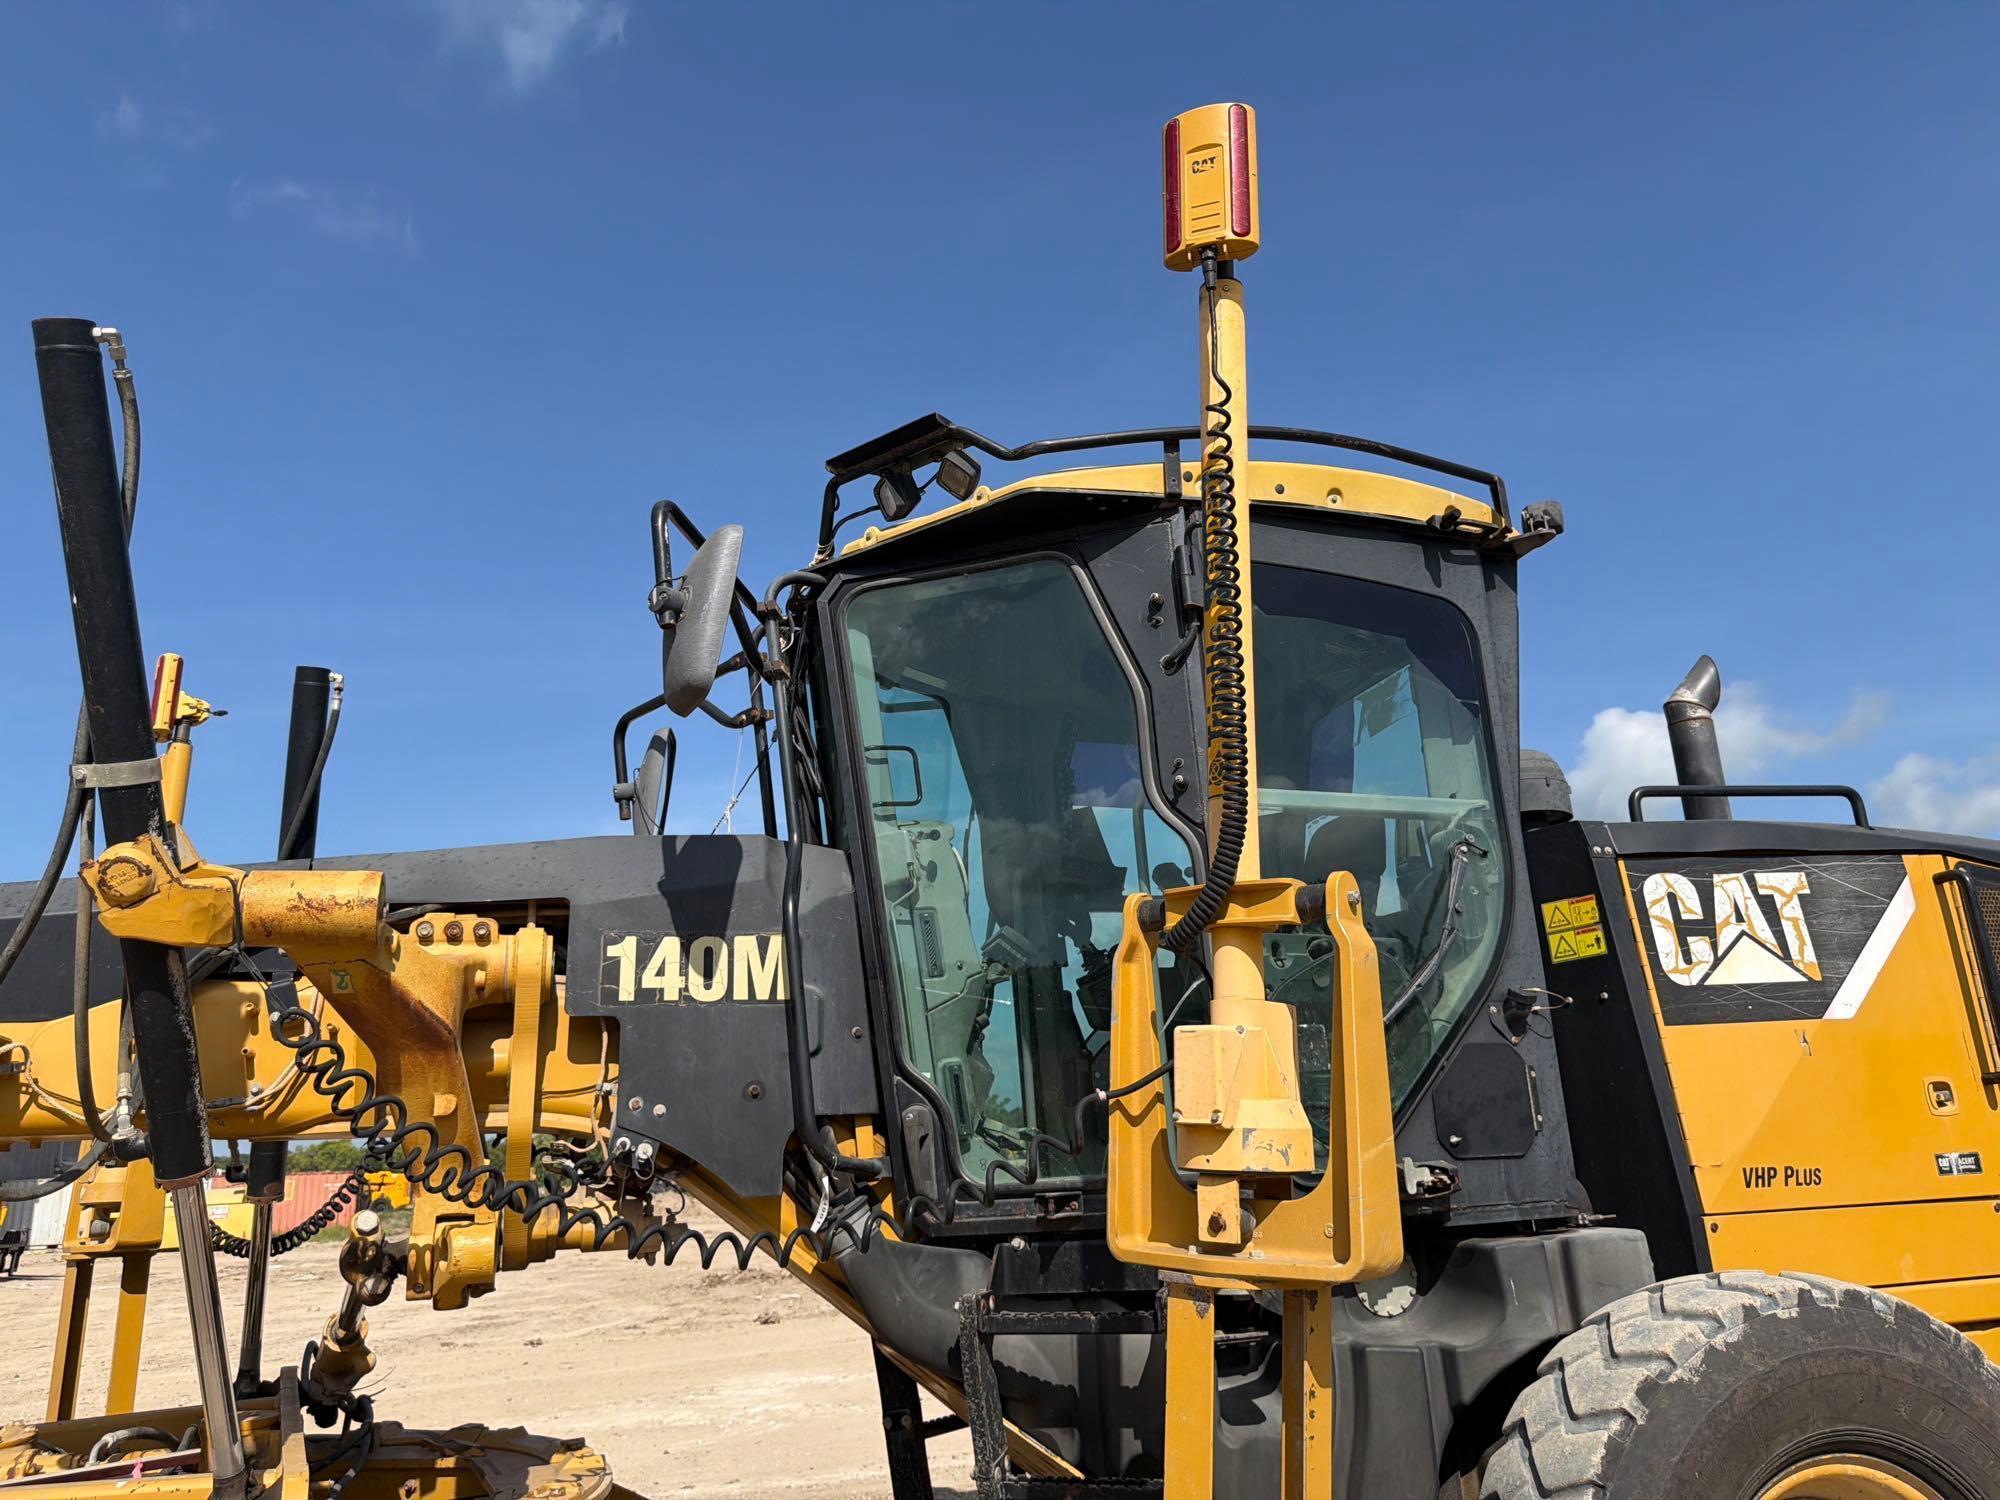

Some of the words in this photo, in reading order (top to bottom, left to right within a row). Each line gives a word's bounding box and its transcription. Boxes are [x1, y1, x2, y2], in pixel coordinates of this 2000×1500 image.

[1192, 156, 1216, 174] CAT
[1643, 872, 1822, 986] CAT
[606, 935, 790, 1002] 140M
[1742, 1166, 1777, 1188] VHP
